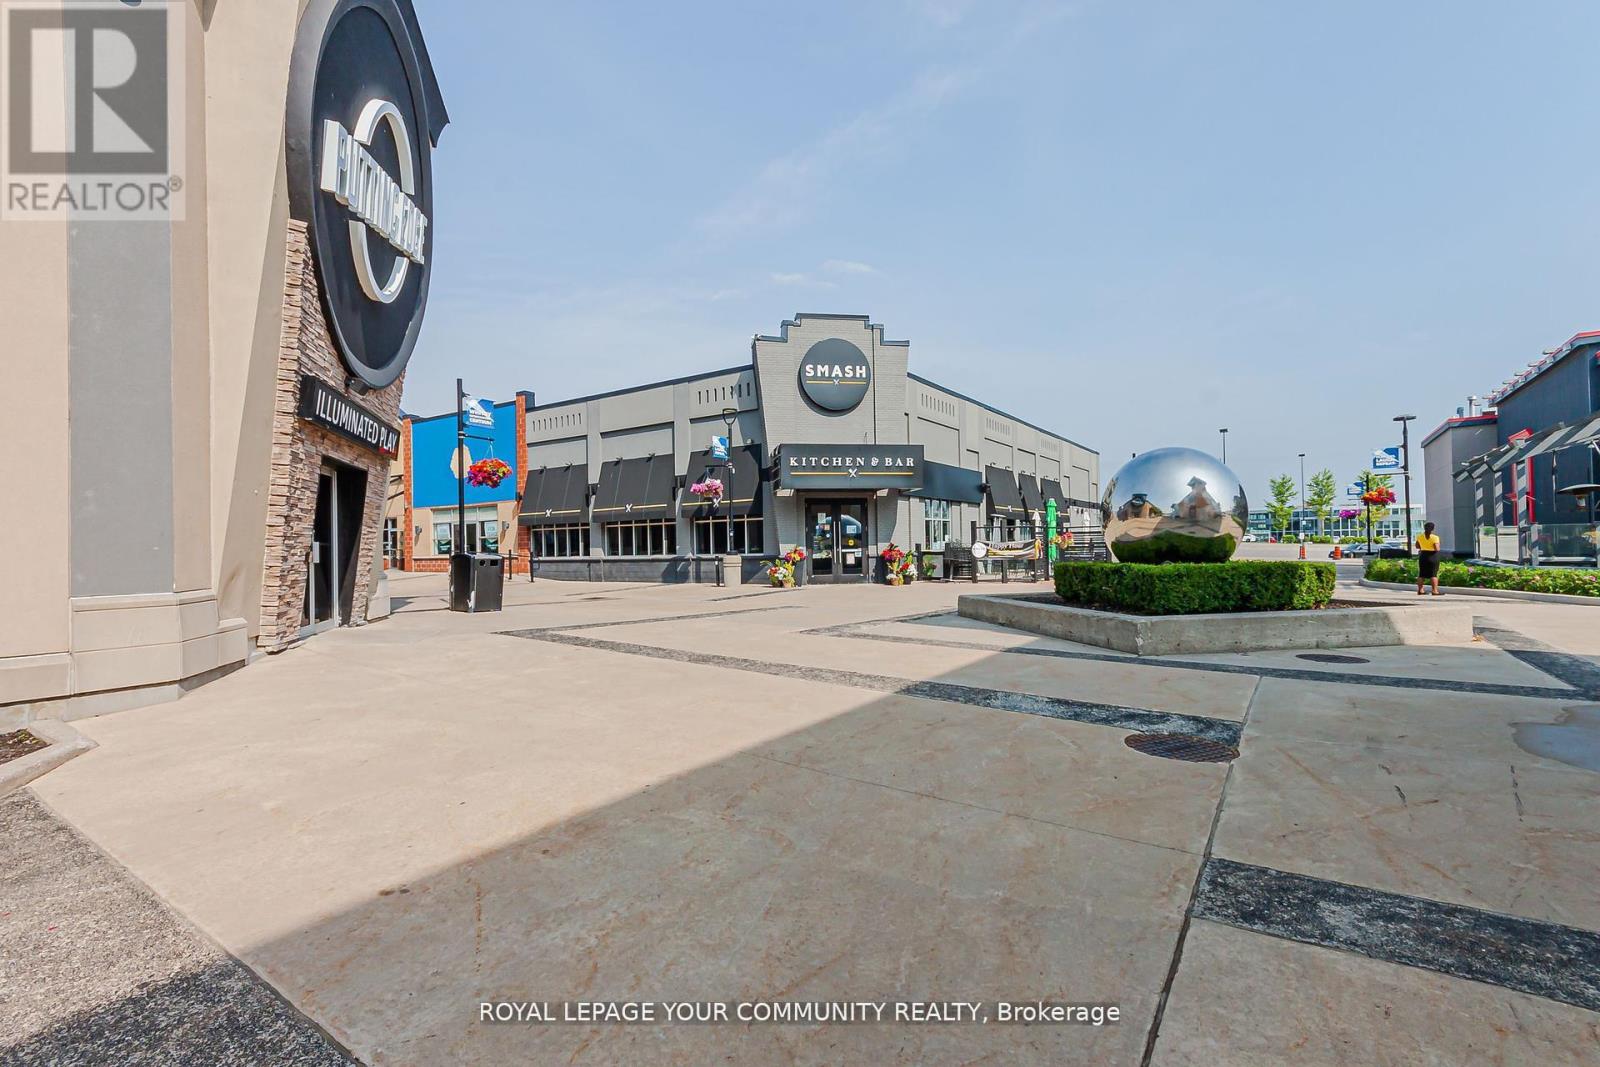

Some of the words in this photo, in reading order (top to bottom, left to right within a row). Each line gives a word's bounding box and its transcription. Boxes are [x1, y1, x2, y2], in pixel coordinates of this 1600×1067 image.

[805, 364, 867, 378] SMASH
[315, 389, 379, 444] ILLUMINATED
[379, 426, 398, 453] PLAY
[789, 457, 865, 467] KITCHEN
[871, 457, 879, 467] &
[885, 458, 915, 467] BAR
